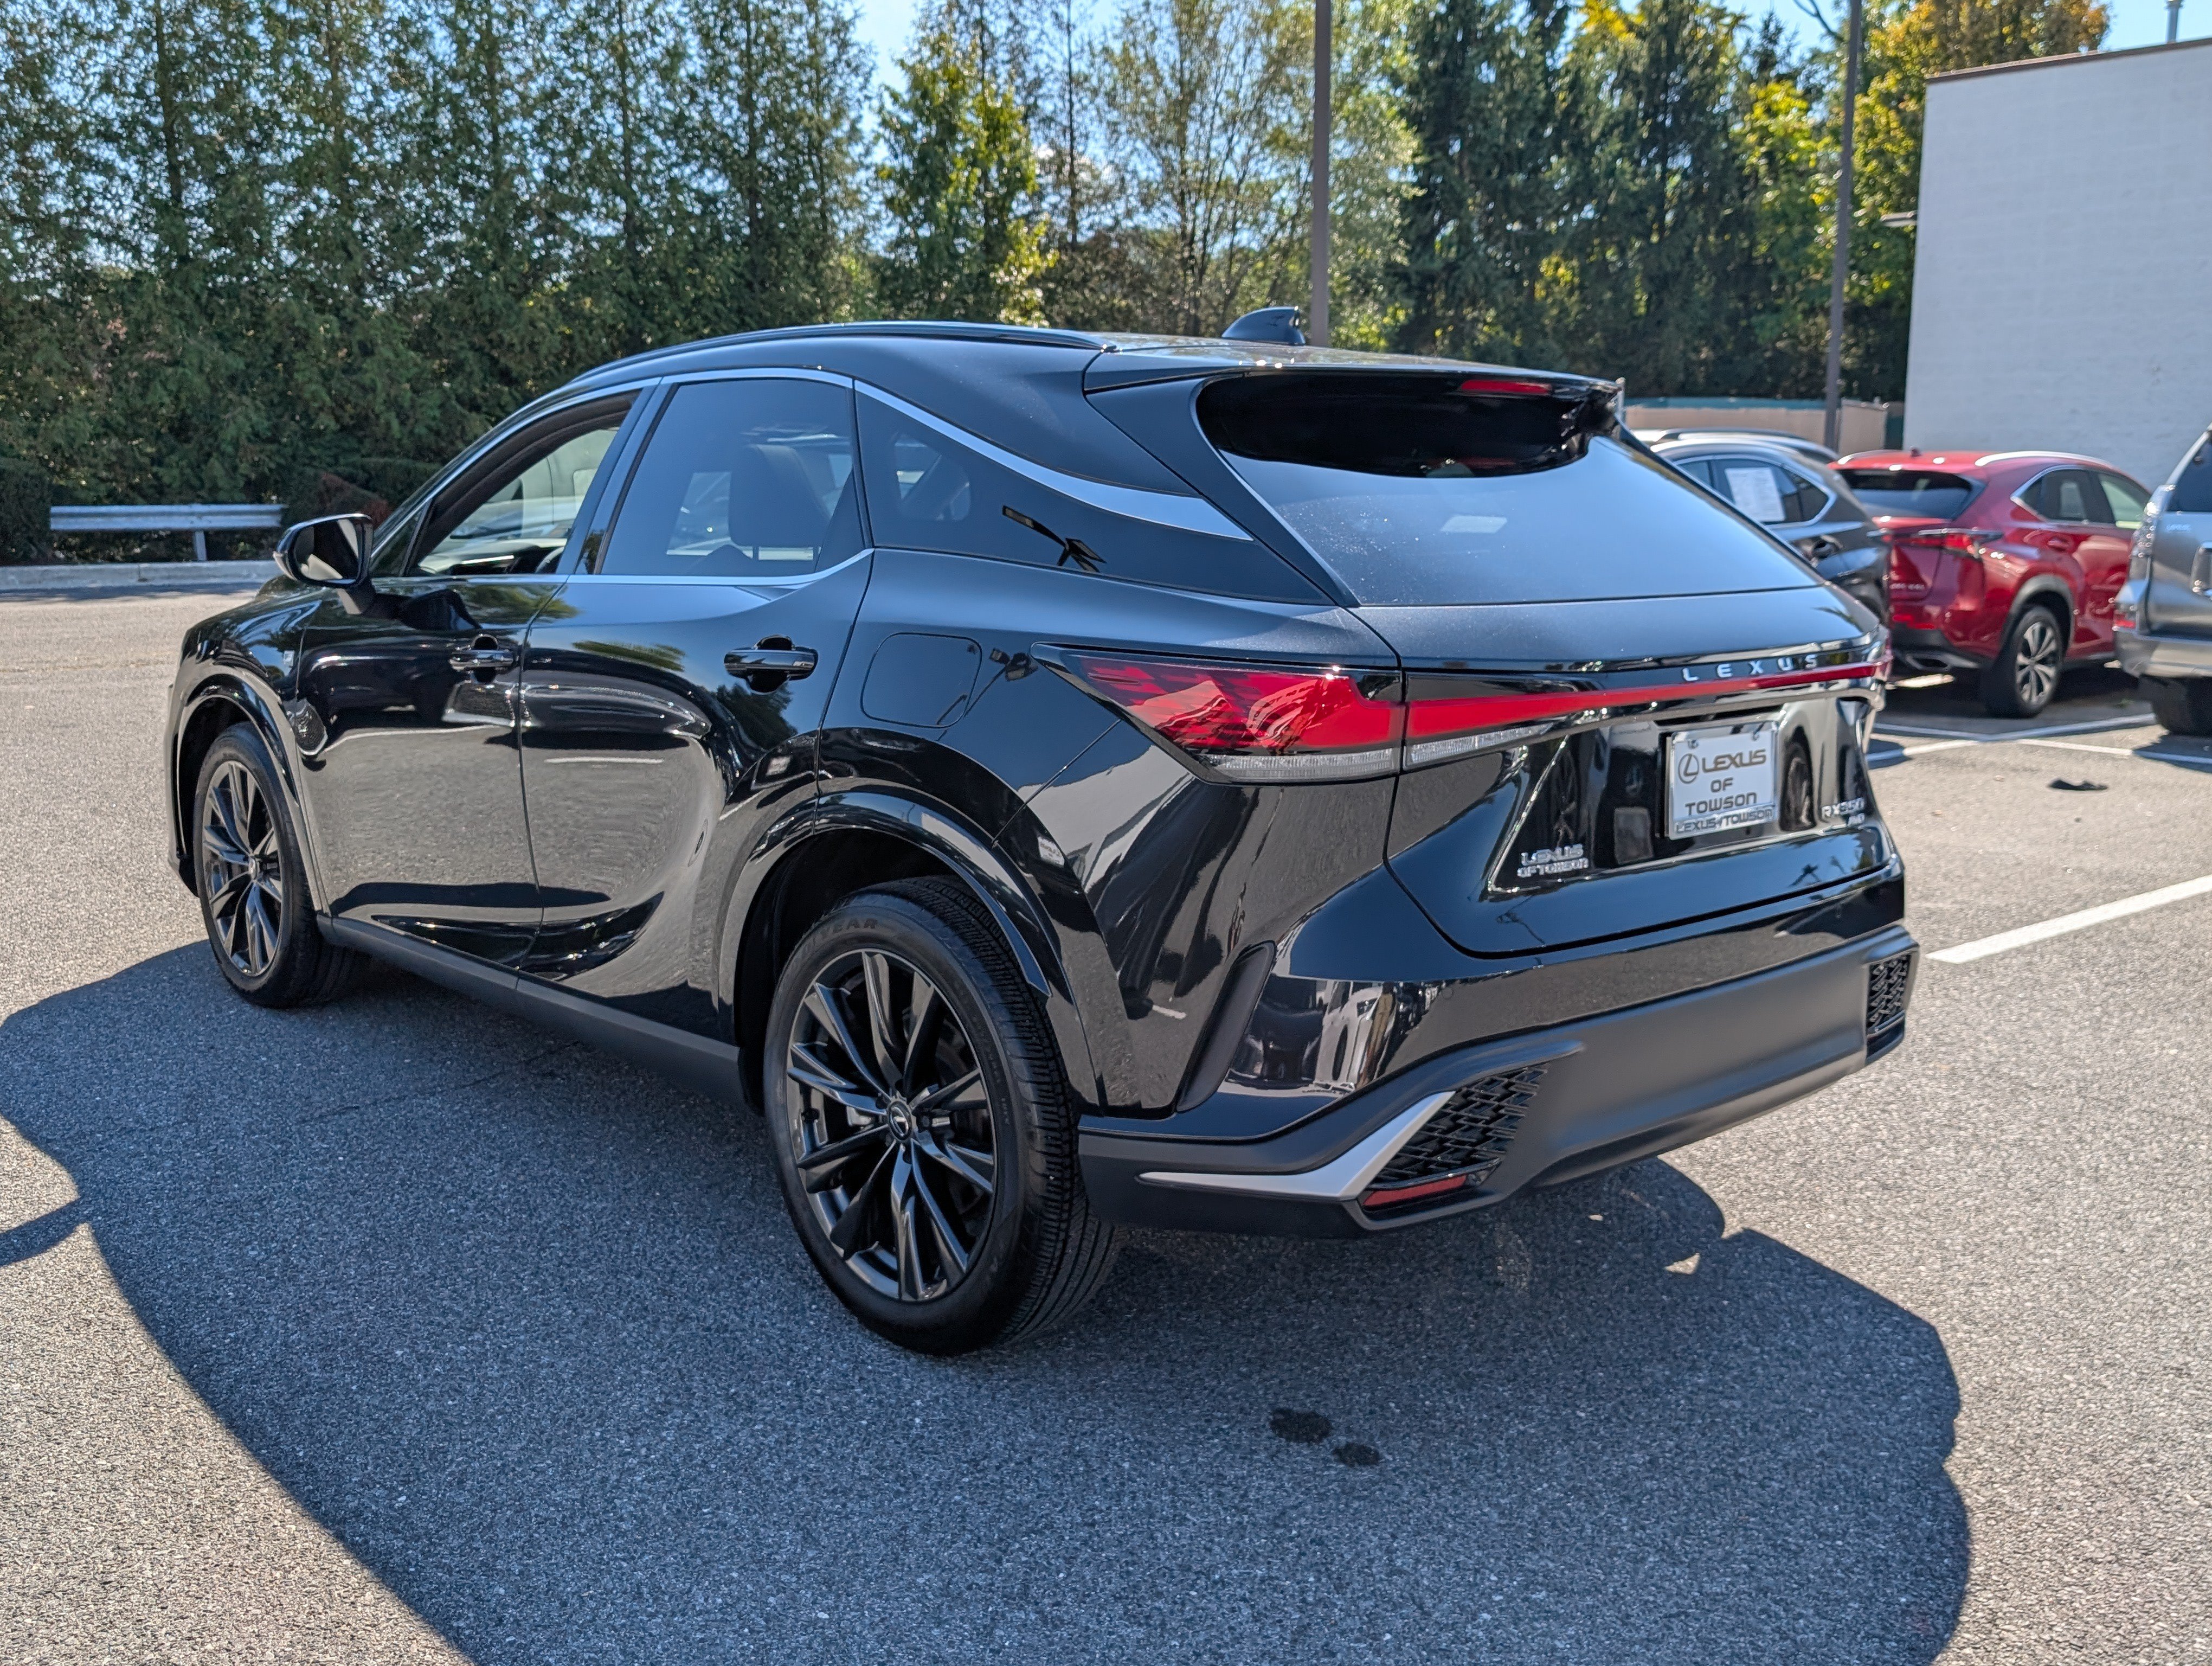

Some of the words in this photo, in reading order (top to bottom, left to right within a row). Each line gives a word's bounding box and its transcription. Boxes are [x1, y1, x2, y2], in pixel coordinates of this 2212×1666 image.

[1682, 653, 1817, 682] LEXUS
[1701, 748, 1767, 773] LEXUS
[1710, 777, 1734, 793] OF
[1520, 843, 1584, 866] LEXUS
